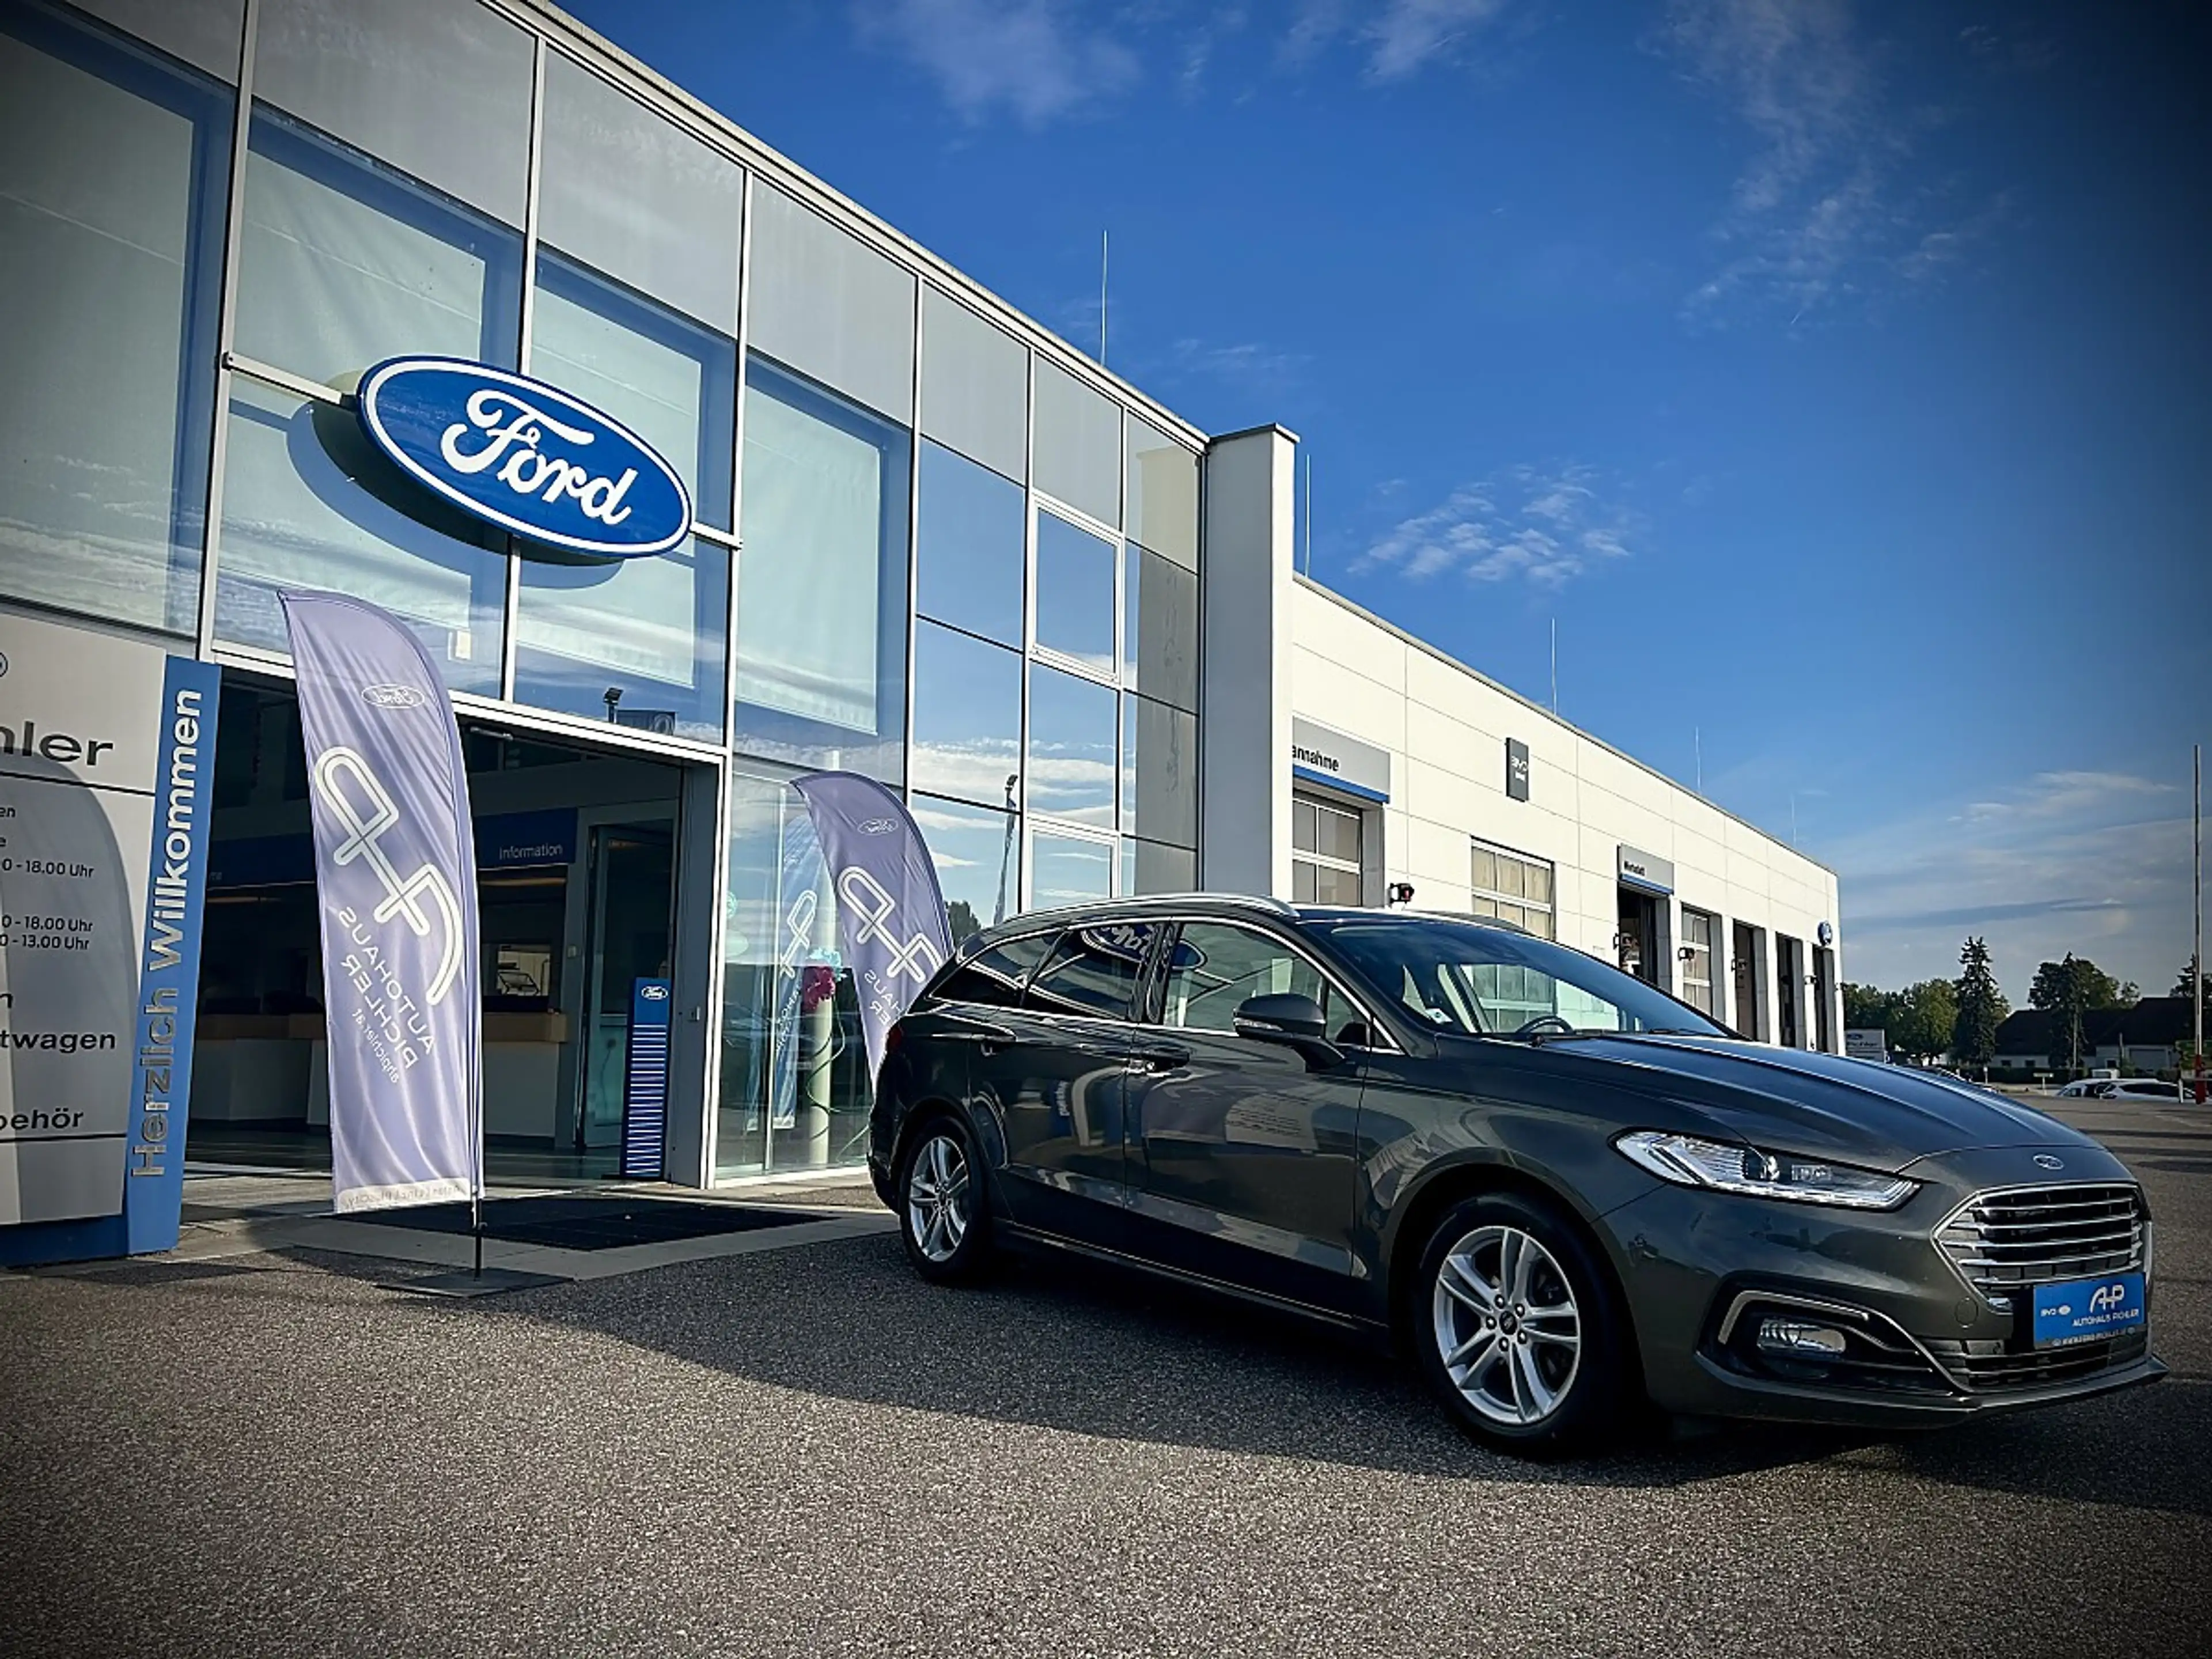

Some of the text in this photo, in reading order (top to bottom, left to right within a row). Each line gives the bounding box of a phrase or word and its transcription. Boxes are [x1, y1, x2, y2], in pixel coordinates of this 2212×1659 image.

[441, 389, 638, 525] Ford
[499, 843, 563, 860] Information
[26, 860, 65, 874] 18.00
[70, 863, 94, 877] Uhr
[25, 916, 65, 930] 18.00
[68, 919, 93, 931] Uhr
[132, 690, 201, 1176] Herzlich Willkommen
[22, 934, 60, 948] 13.00
[65, 937, 89, 950] Uhr
[0, 1030, 115, 1054] twagen
